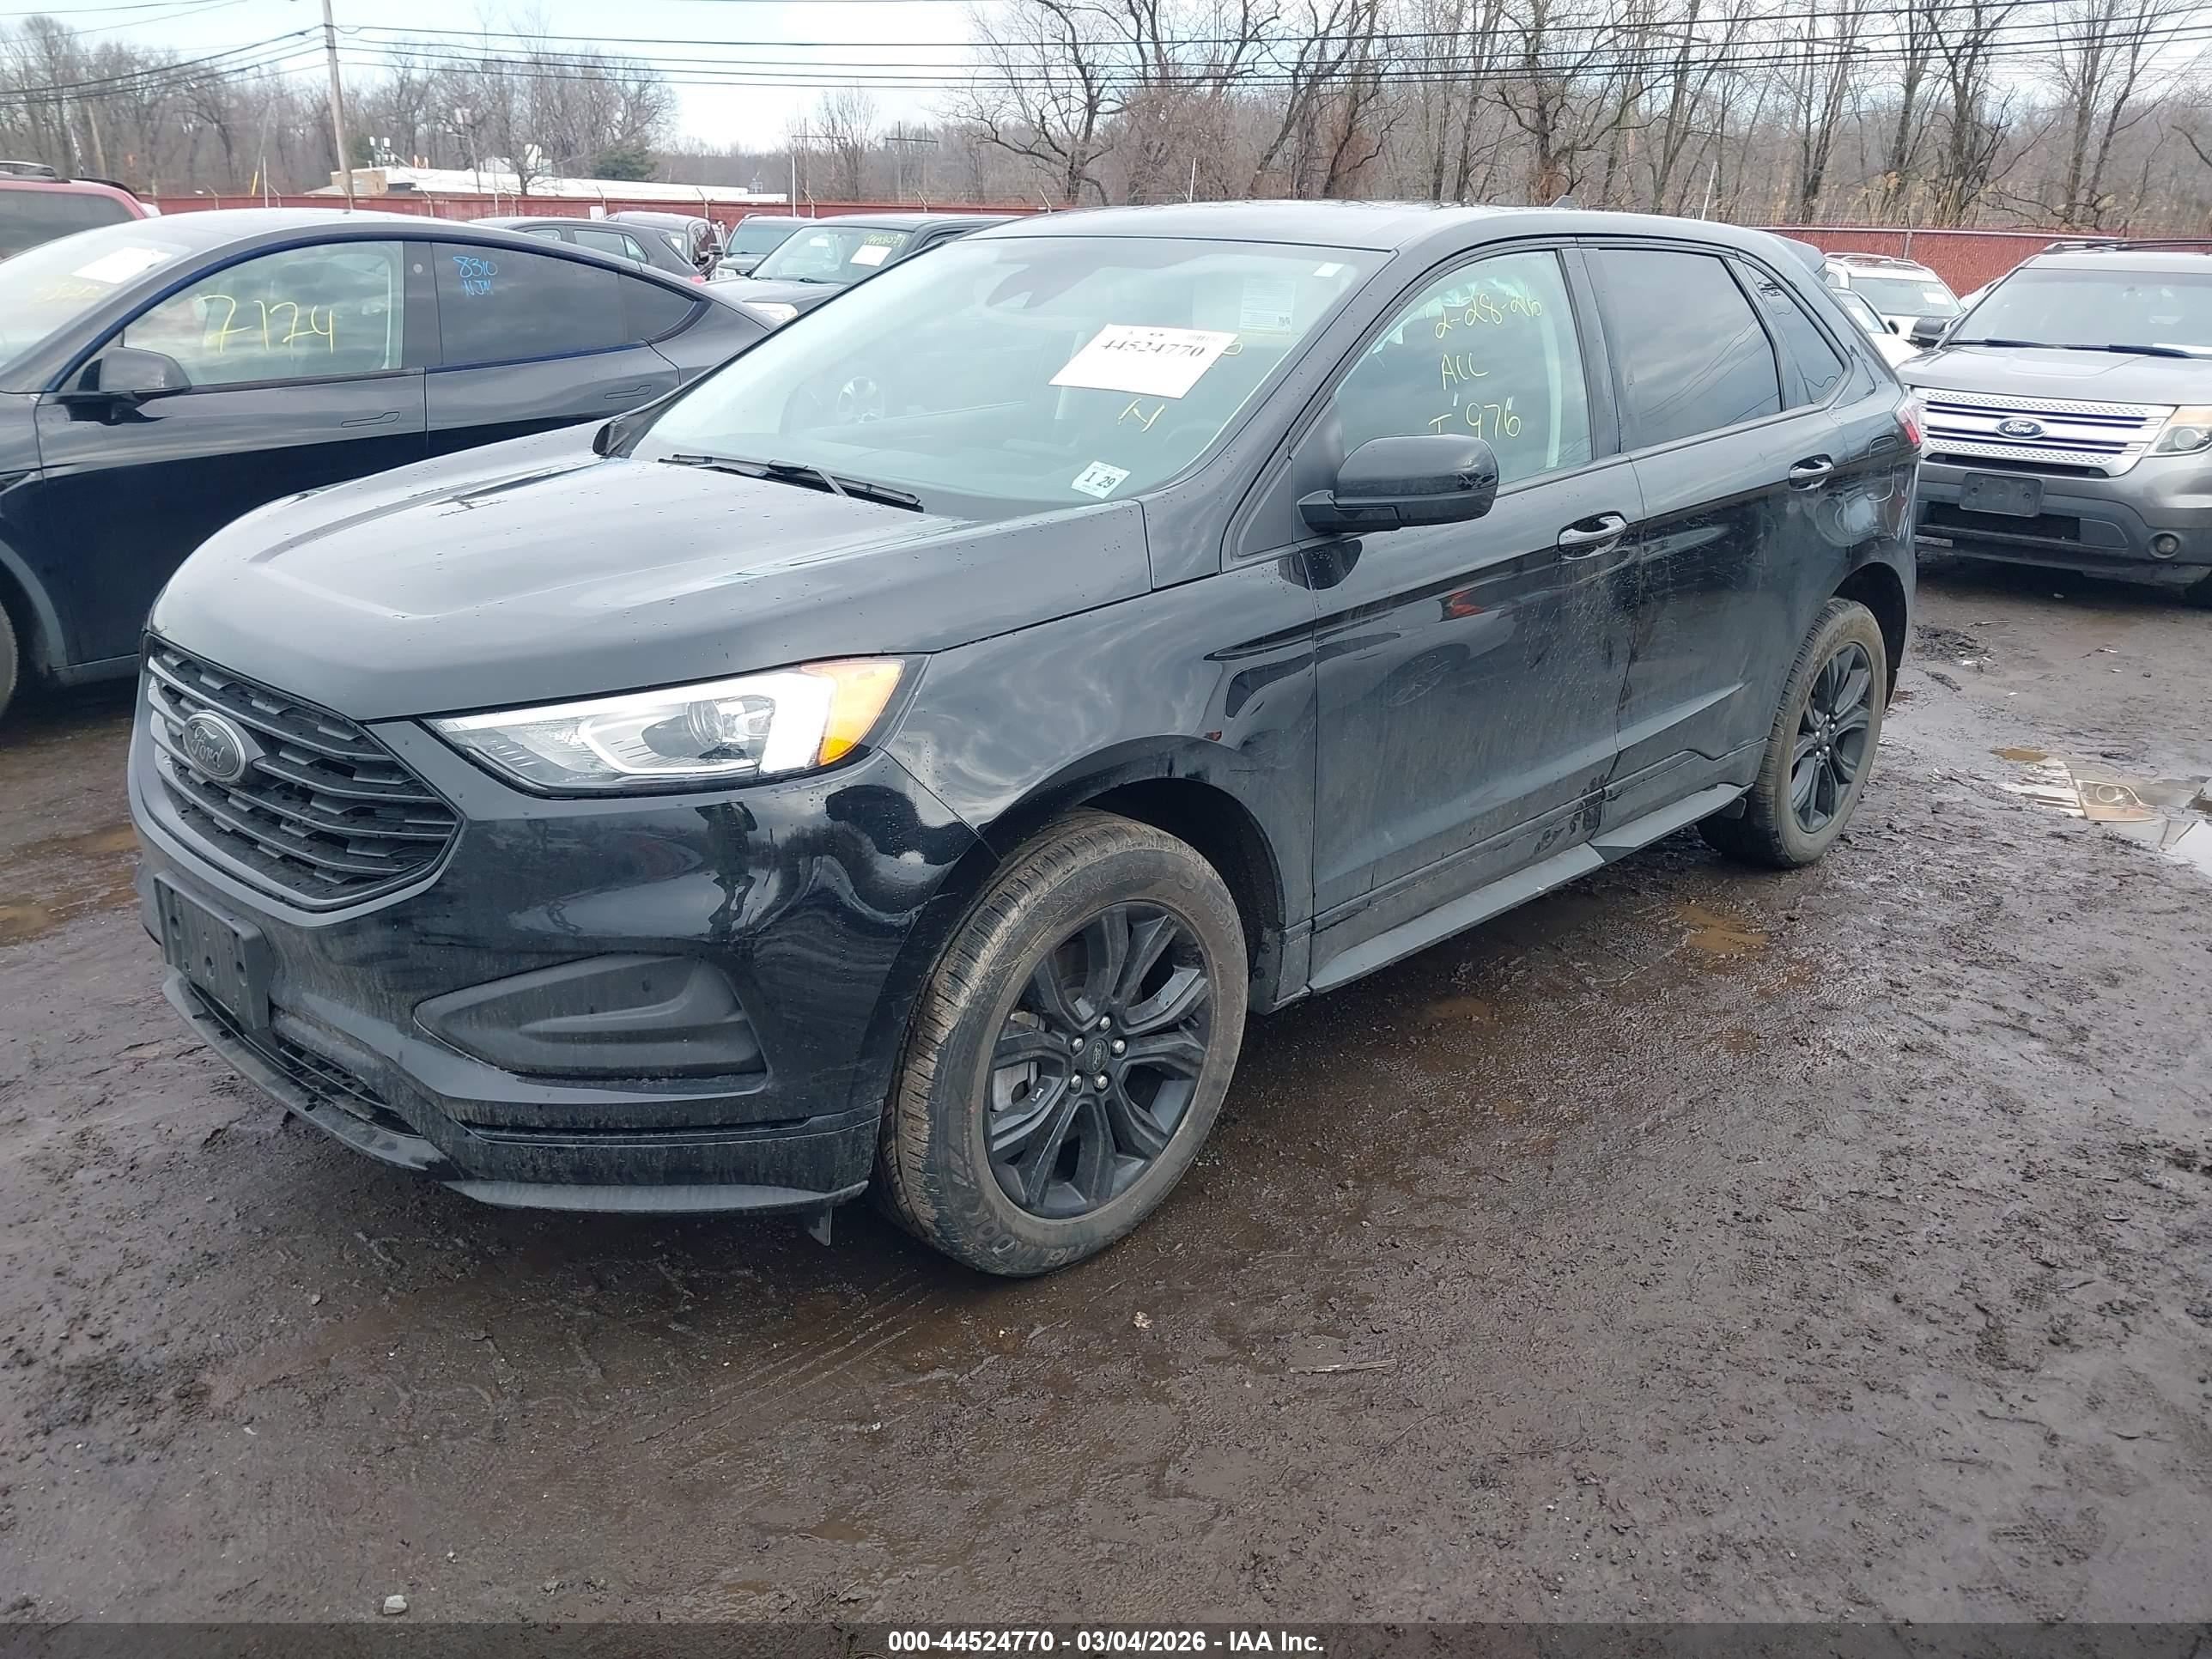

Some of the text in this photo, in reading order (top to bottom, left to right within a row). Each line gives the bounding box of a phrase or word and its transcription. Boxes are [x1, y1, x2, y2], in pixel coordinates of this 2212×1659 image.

[453, 256, 498, 277] 8310
[1102, 340, 1205, 357] 44524770
[2005, 422, 2035, 433] Ford
[1096, 476, 1116, 489] 29
[191, 726, 225, 769] Ford
